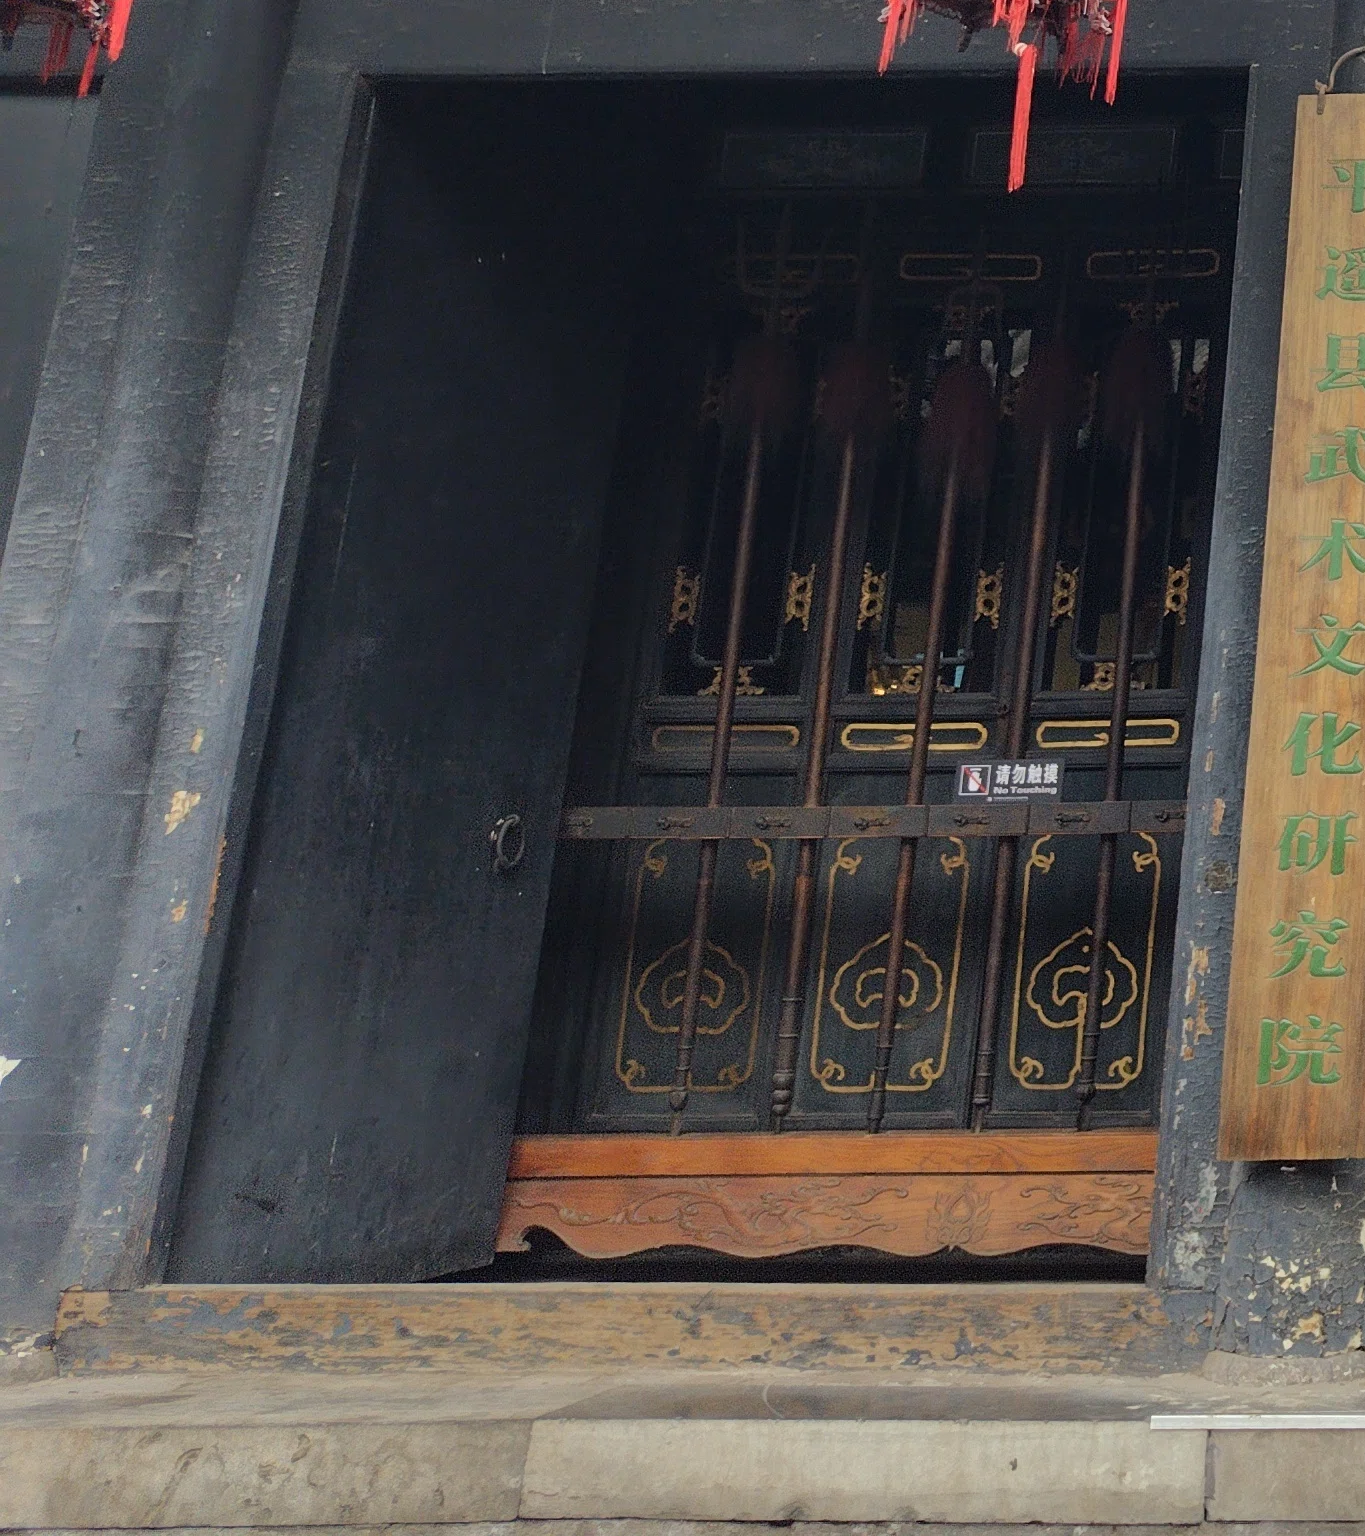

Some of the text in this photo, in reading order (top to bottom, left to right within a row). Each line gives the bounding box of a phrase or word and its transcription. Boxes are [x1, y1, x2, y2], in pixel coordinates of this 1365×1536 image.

[995, 763, 1059, 785] 请勿触摸
[993, 785, 1058, 795] No Touching
